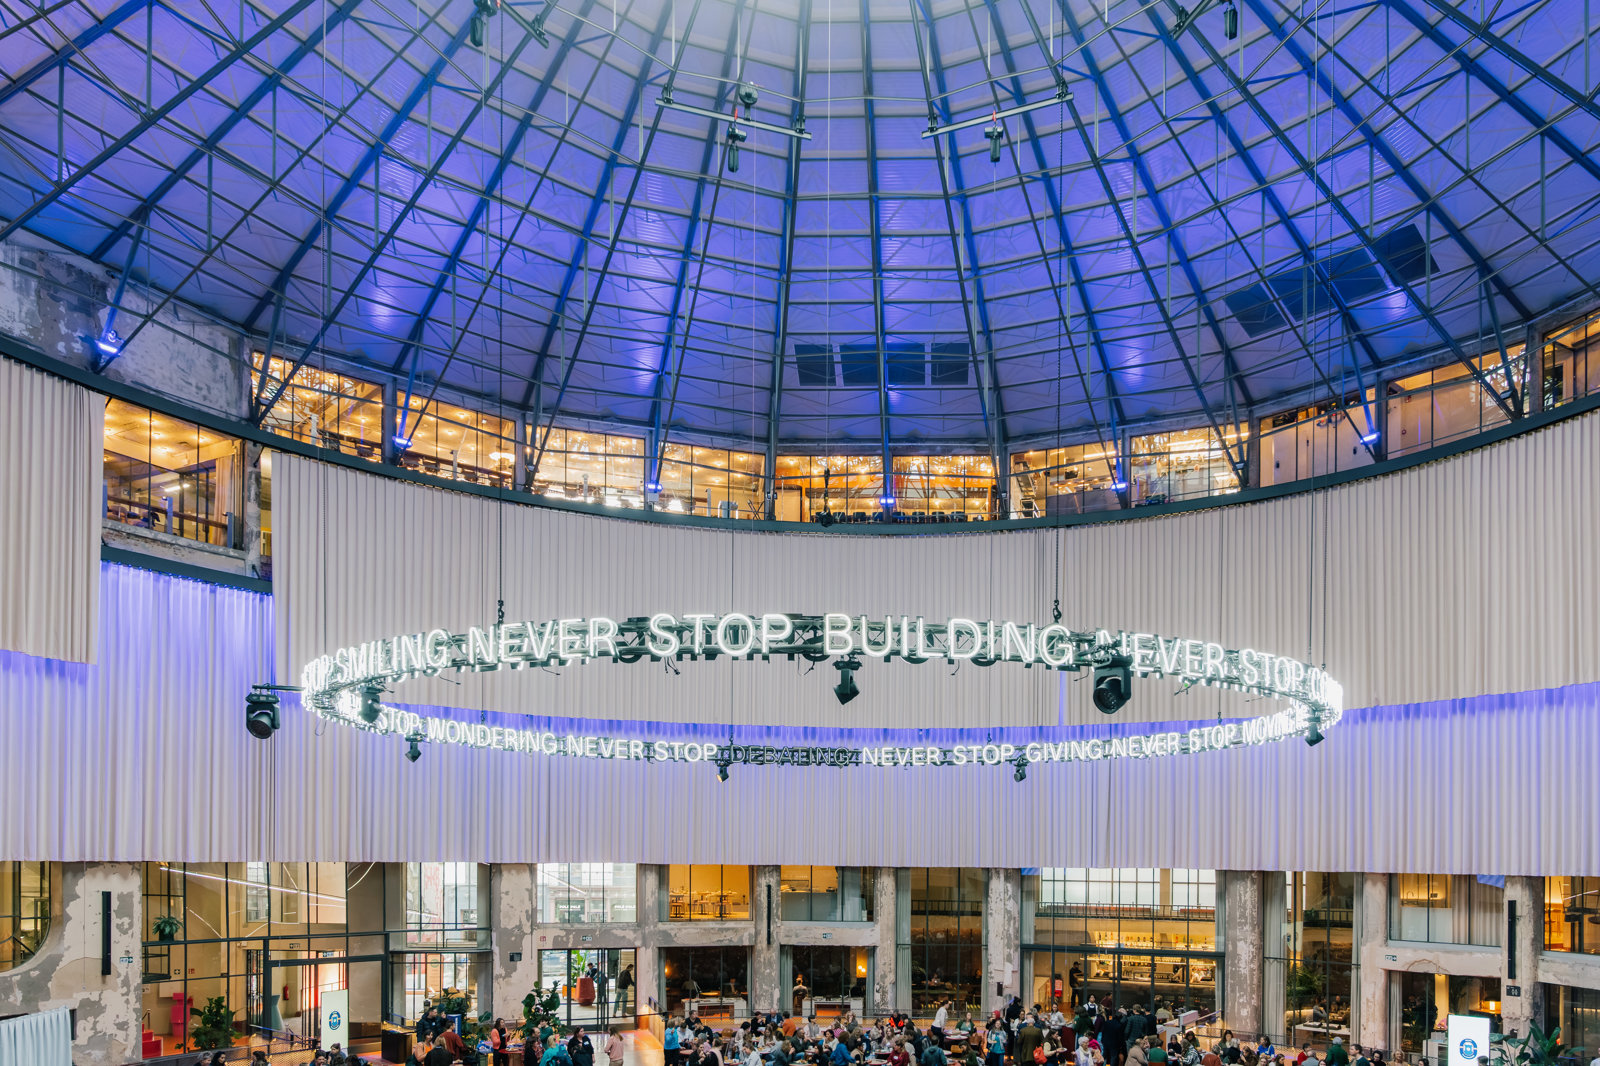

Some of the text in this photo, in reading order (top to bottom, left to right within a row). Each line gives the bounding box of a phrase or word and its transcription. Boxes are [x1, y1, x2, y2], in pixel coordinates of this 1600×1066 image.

[336, 628, 450, 682] SMILING
[469, 617, 618, 664] NEVER
[648, 613, 793, 657] STOP
[823, 613, 1074, 667] BUILDING
[1097, 629, 1225, 679] NEVER
[1241, 648, 1305, 692] STOP
[379, 704, 421, 736] STOP
[427, 717, 556, 754] WONDERING
[566, 734, 643, 760] NEVER
[653, 740, 718, 763] STOP
[731, 744, 851, 766] DEBATING
[862, 747, 941, 766] NEVER
[953, 743, 1014, 765] STOP
[1026, 739, 1102, 763] GIVING
[1112, 732, 1180, 758] NEVER
[1189, 724, 1236, 753] STOP
